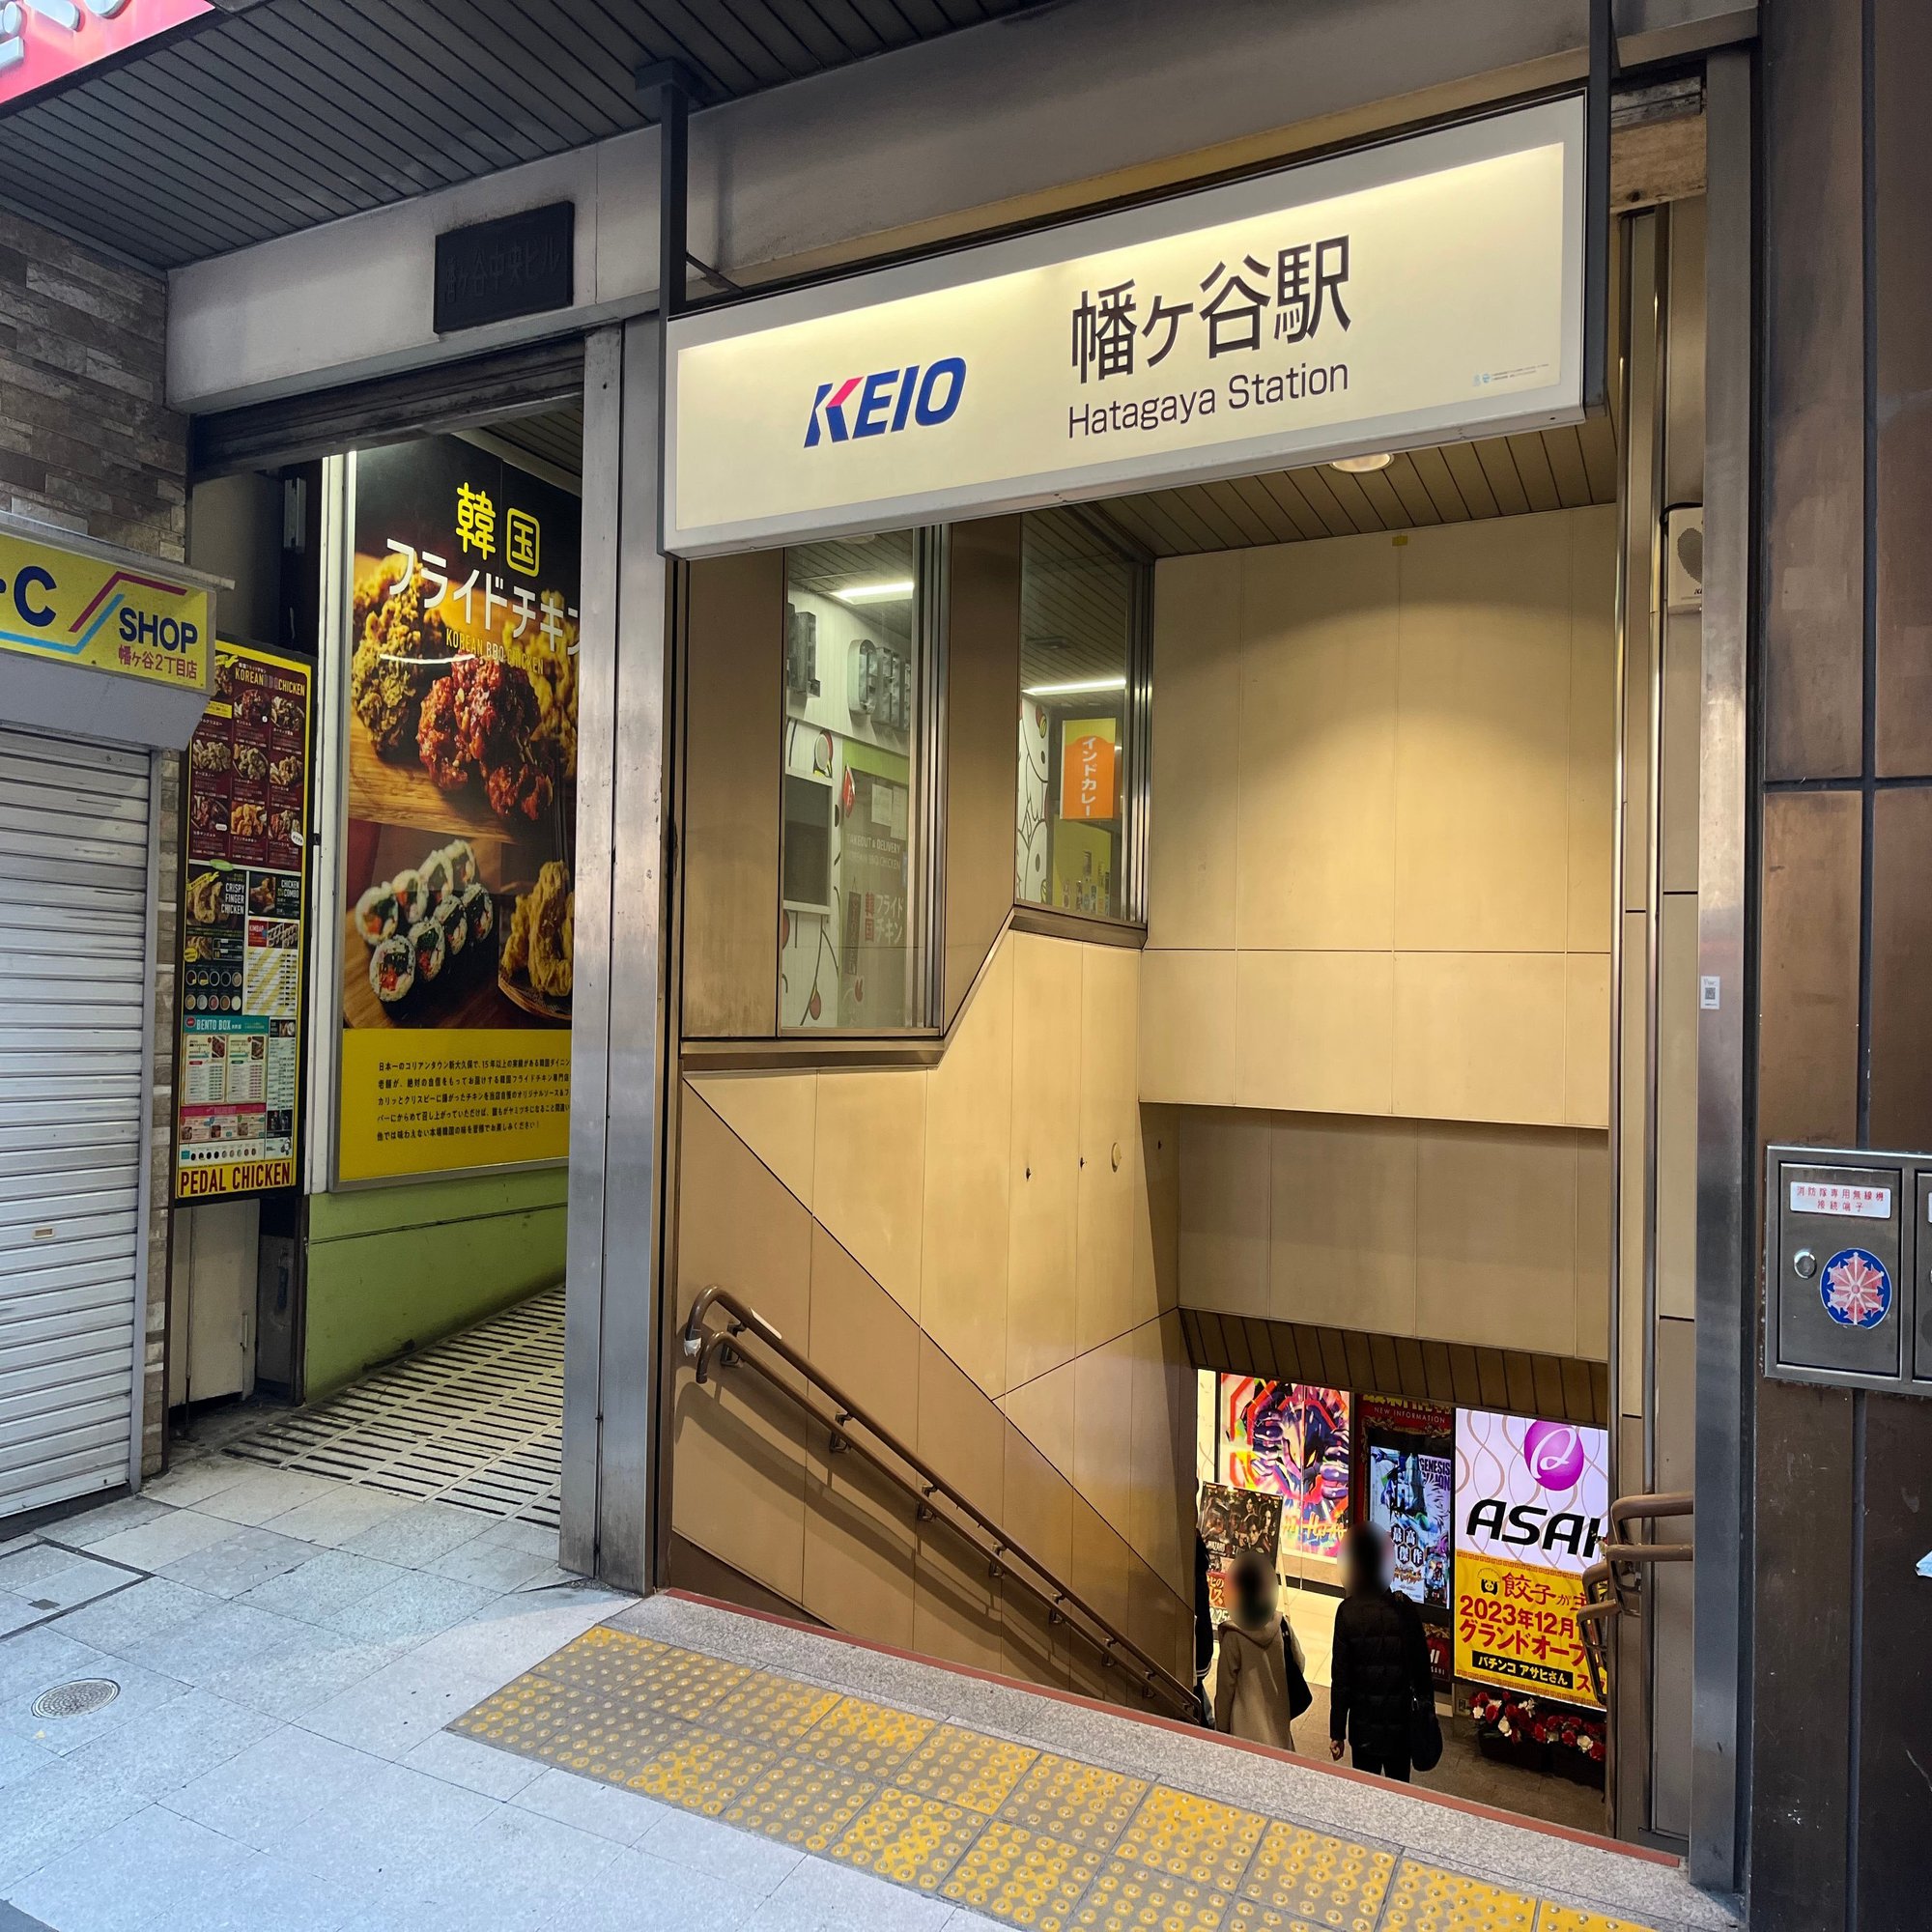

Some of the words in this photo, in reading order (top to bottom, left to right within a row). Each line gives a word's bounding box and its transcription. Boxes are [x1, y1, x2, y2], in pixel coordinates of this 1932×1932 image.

[803, 356, 967, 448] KEIO
[1068, 389, 1215, 440] Hatagaya
[1228, 358, 1350, 411] Station
[455, 481, 541, 578] 韓国
[119, 607, 198, 654] SHOP
[446, 628, 483, 656] KOREAN
[486, 641, 504, 662] BBQ
[507, 649, 543, 675] CHICKEN
[235, 667, 264, 686] KOREAN
[278, 678, 305, 696] CHICKEN
[1081, 736, 1097, 817] インドカレー
[846, 833, 871, 848] TAKEOUT
[877, 838, 900, 854] DELIVERY
[225, 883, 244, 894] CRISPY
[281, 879, 299, 889] CHICKEN
[220, 903, 244, 915] CHICKEN
[225, 893, 244, 904] FINGER
[875, 894, 904, 915] フライド
[874, 918, 903, 945] チキン
[196, 1019, 216, 1031] BENTO
[218, 1019, 231, 1031] BOX
[180, 1168, 226, 1196] PEDAL
[232, 1162, 290, 1190] CHICKEN
[1797, 1185, 1884, 1202] 消防隊専用無線機
[1817, 1200, 1863, 1212] 接続端子
[1374, 1406, 1390, 1415] NEW
[1393, 1409, 1446, 1424] INFORMATION
[1420, 1457, 1451, 1476] GENESIS
[1520, 1663, 1569, 1687] アサヒさん
